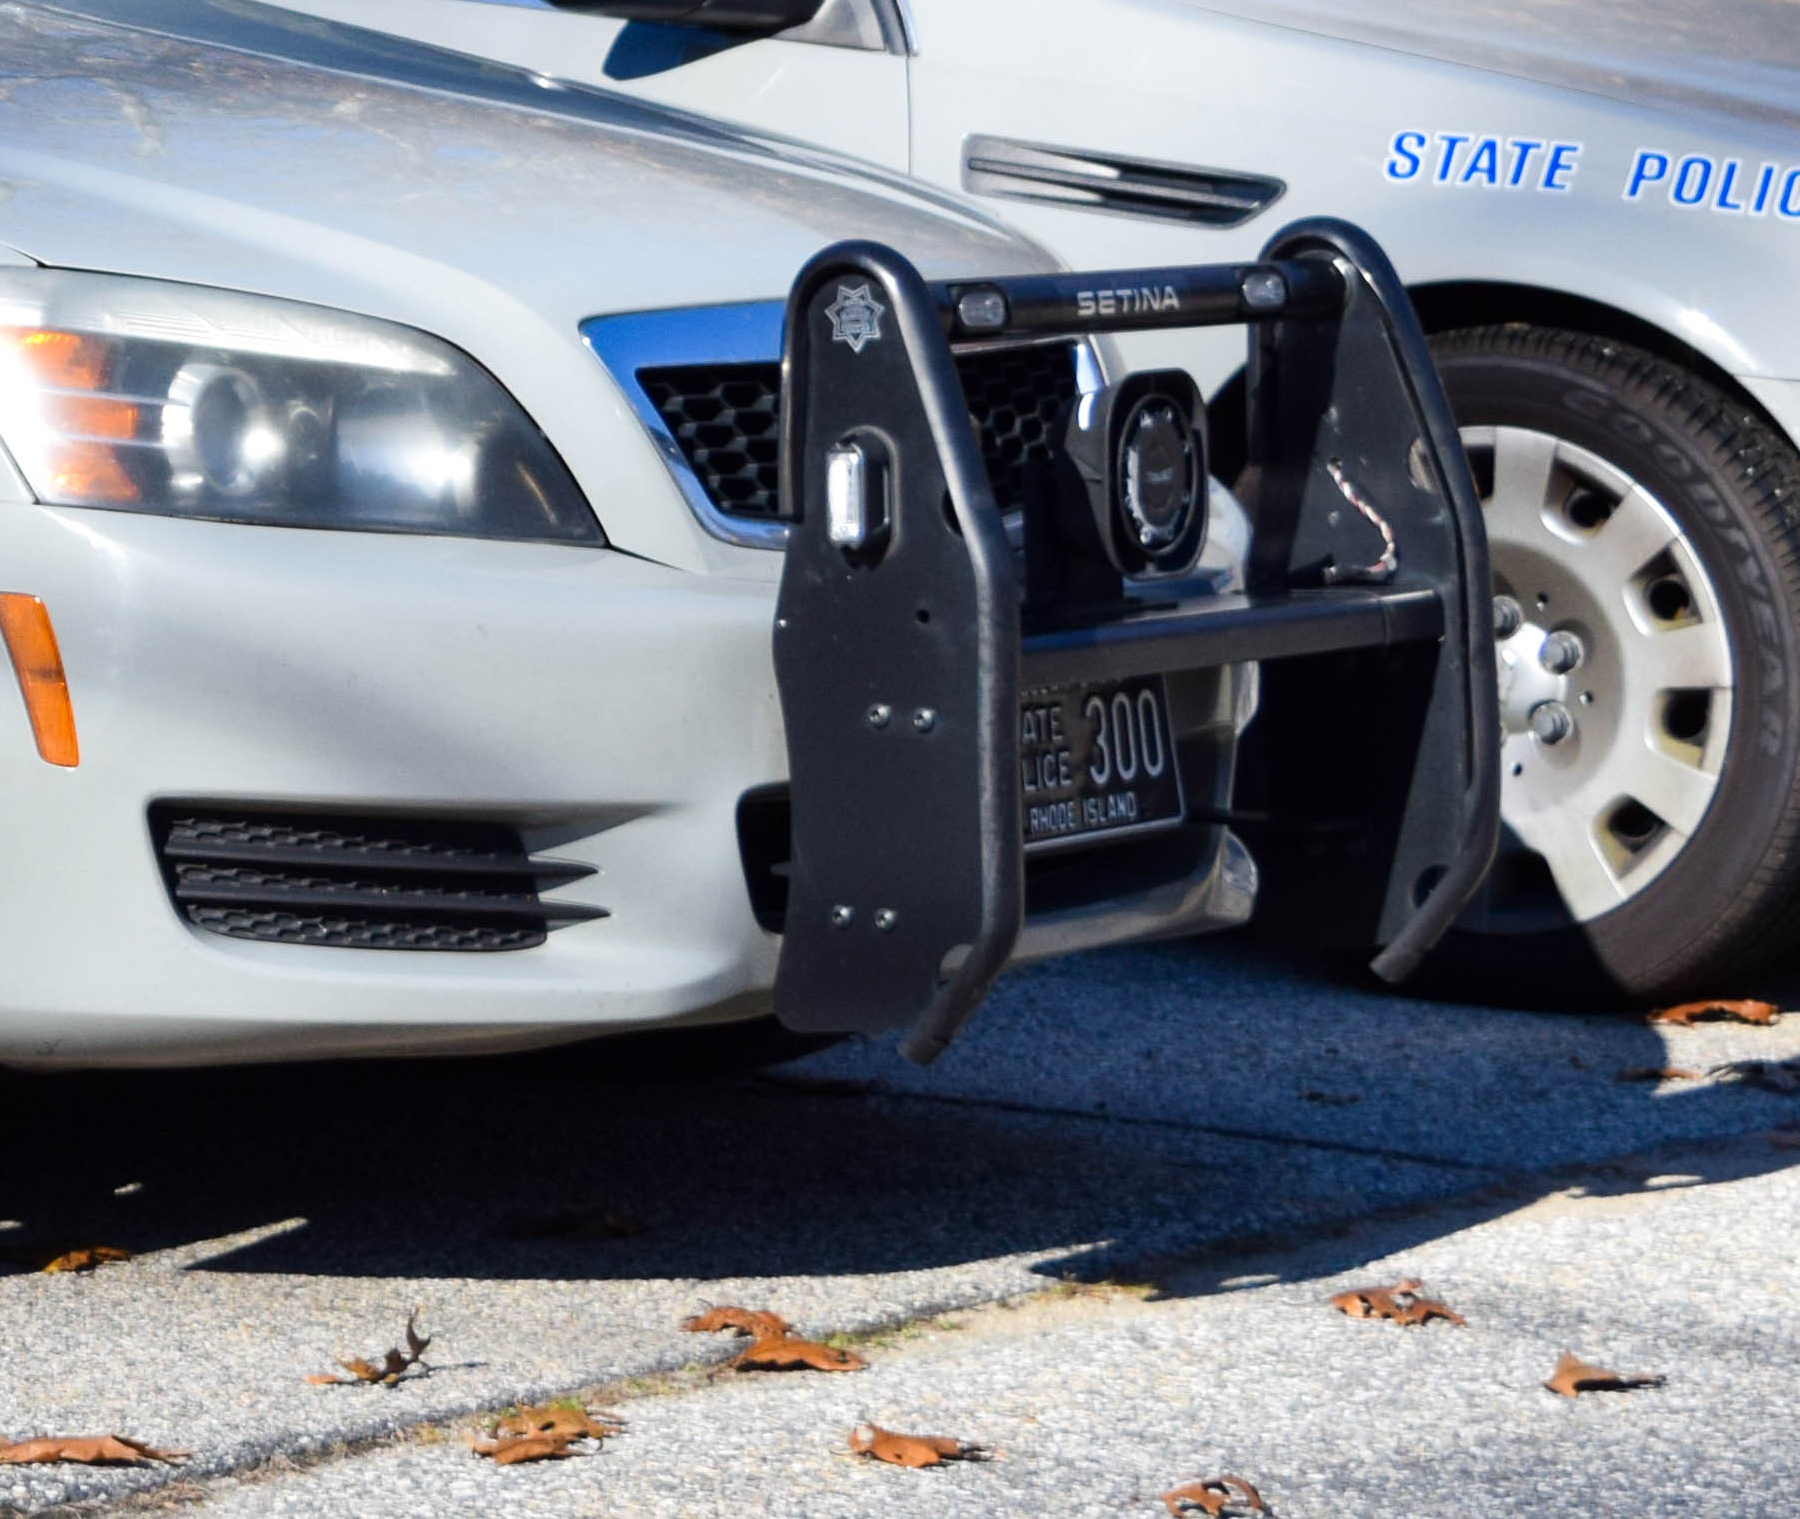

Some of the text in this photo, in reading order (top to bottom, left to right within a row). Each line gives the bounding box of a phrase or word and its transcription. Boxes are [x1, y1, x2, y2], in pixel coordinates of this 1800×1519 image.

[1384, 130, 1581, 194] STATE
[1076, 285, 1181, 317] SETINA
[1086, 689, 1164, 785] 300
[1030, 792, 1137, 833] RHODE ISLAND
